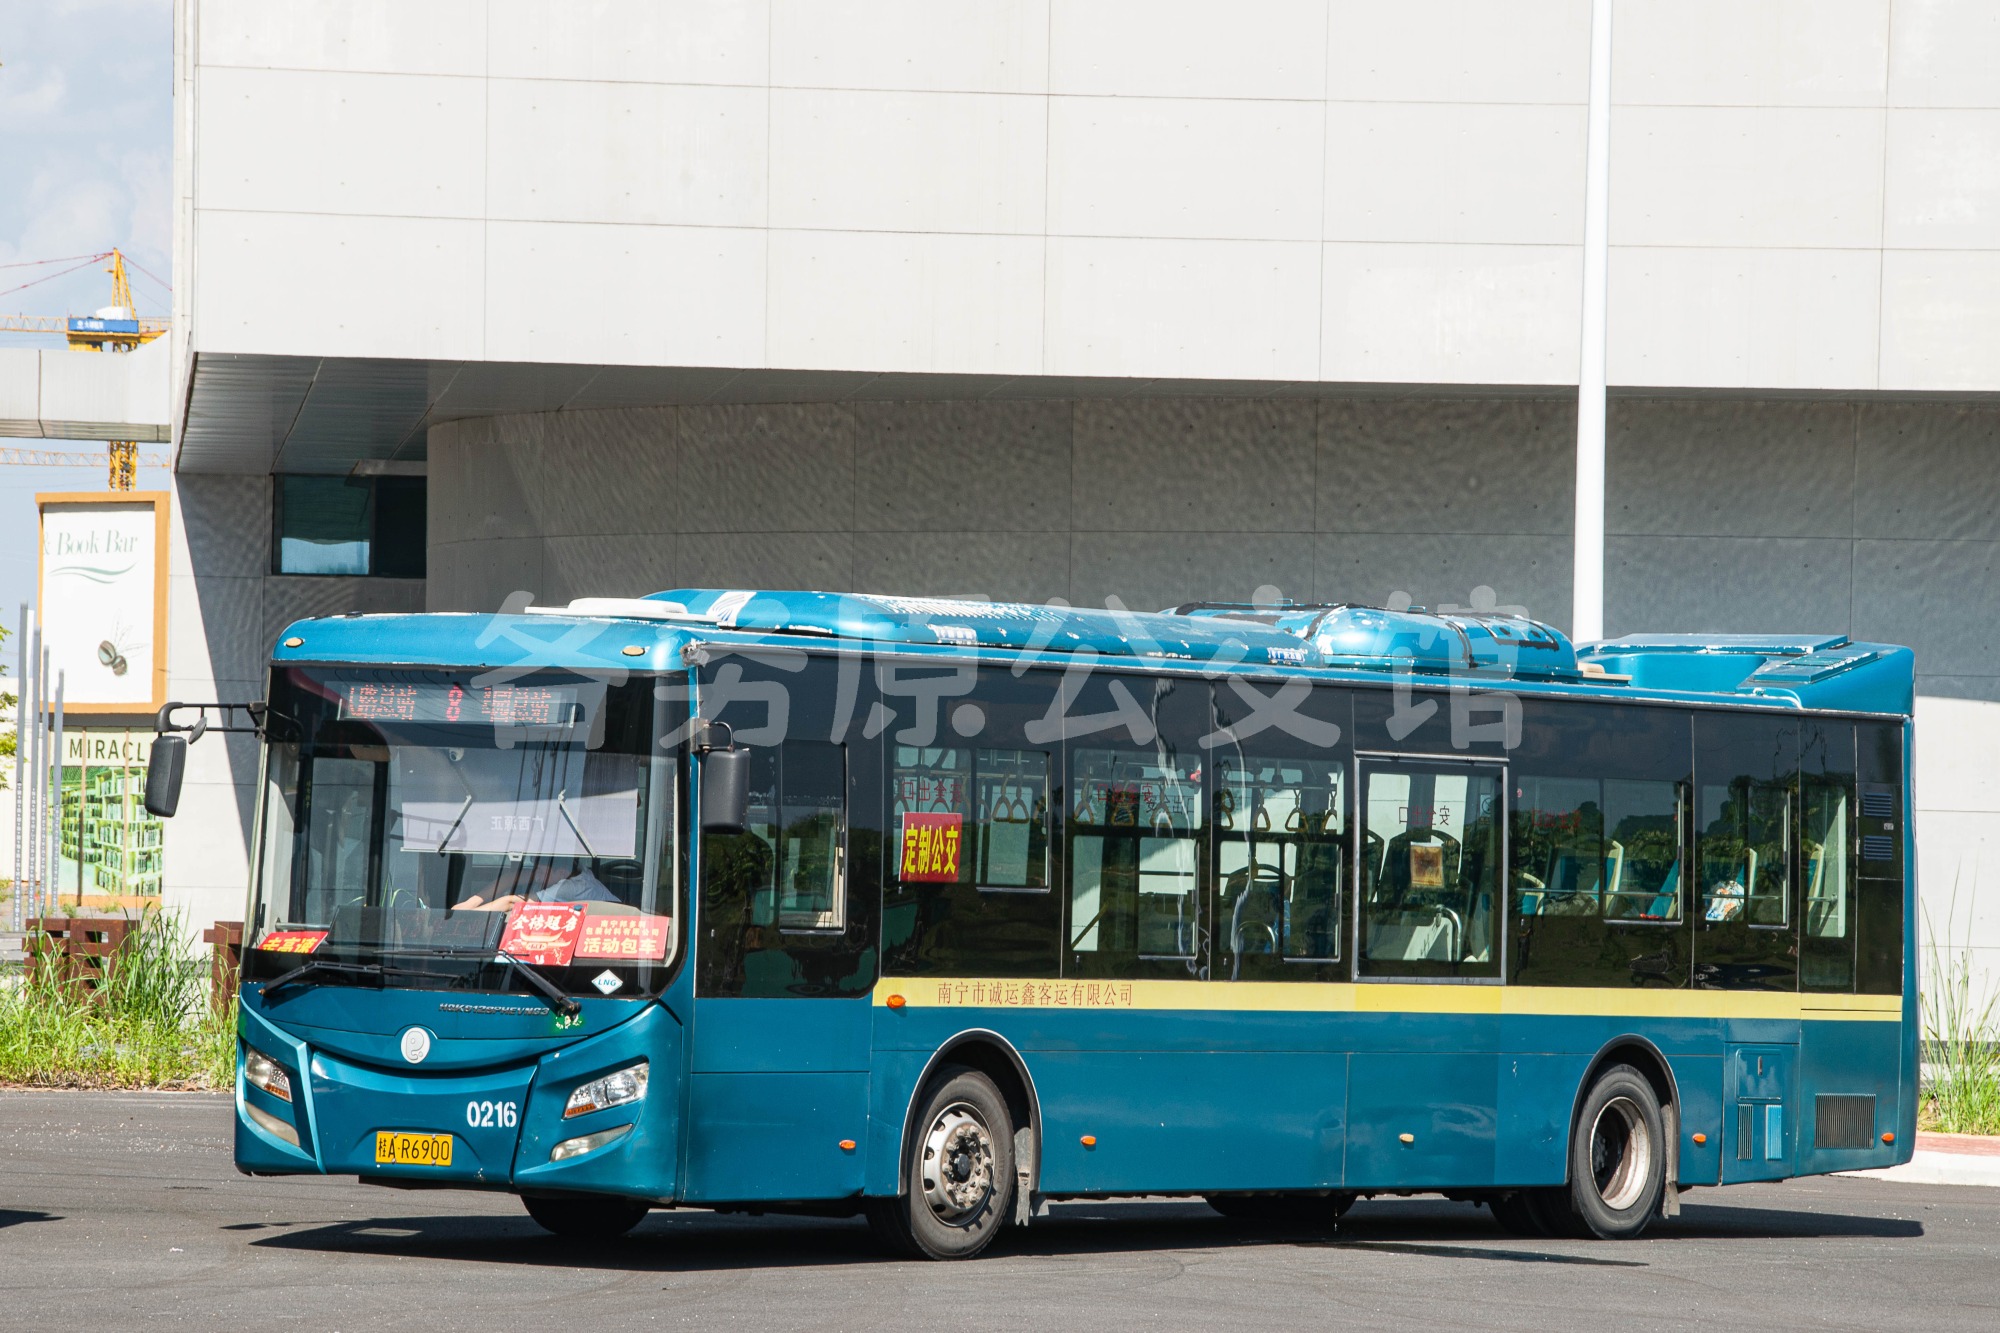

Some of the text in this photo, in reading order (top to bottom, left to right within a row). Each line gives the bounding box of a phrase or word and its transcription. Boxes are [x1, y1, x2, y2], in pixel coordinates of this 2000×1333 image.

[57, 530, 99, 556] Book
[106, 529, 138, 553] Bar
[447, 685, 463, 722] 8
[70, 738, 153, 762] MIRACL
[903, 823, 958, 875] 定制公交
[583, 937, 657, 954] 活动包车
[598, 978, 617, 987] LNG
[938, 981, 1132, 1006] 南宁市诚运鑫客运有限公司
[466, 1100, 517, 1128] 0216
